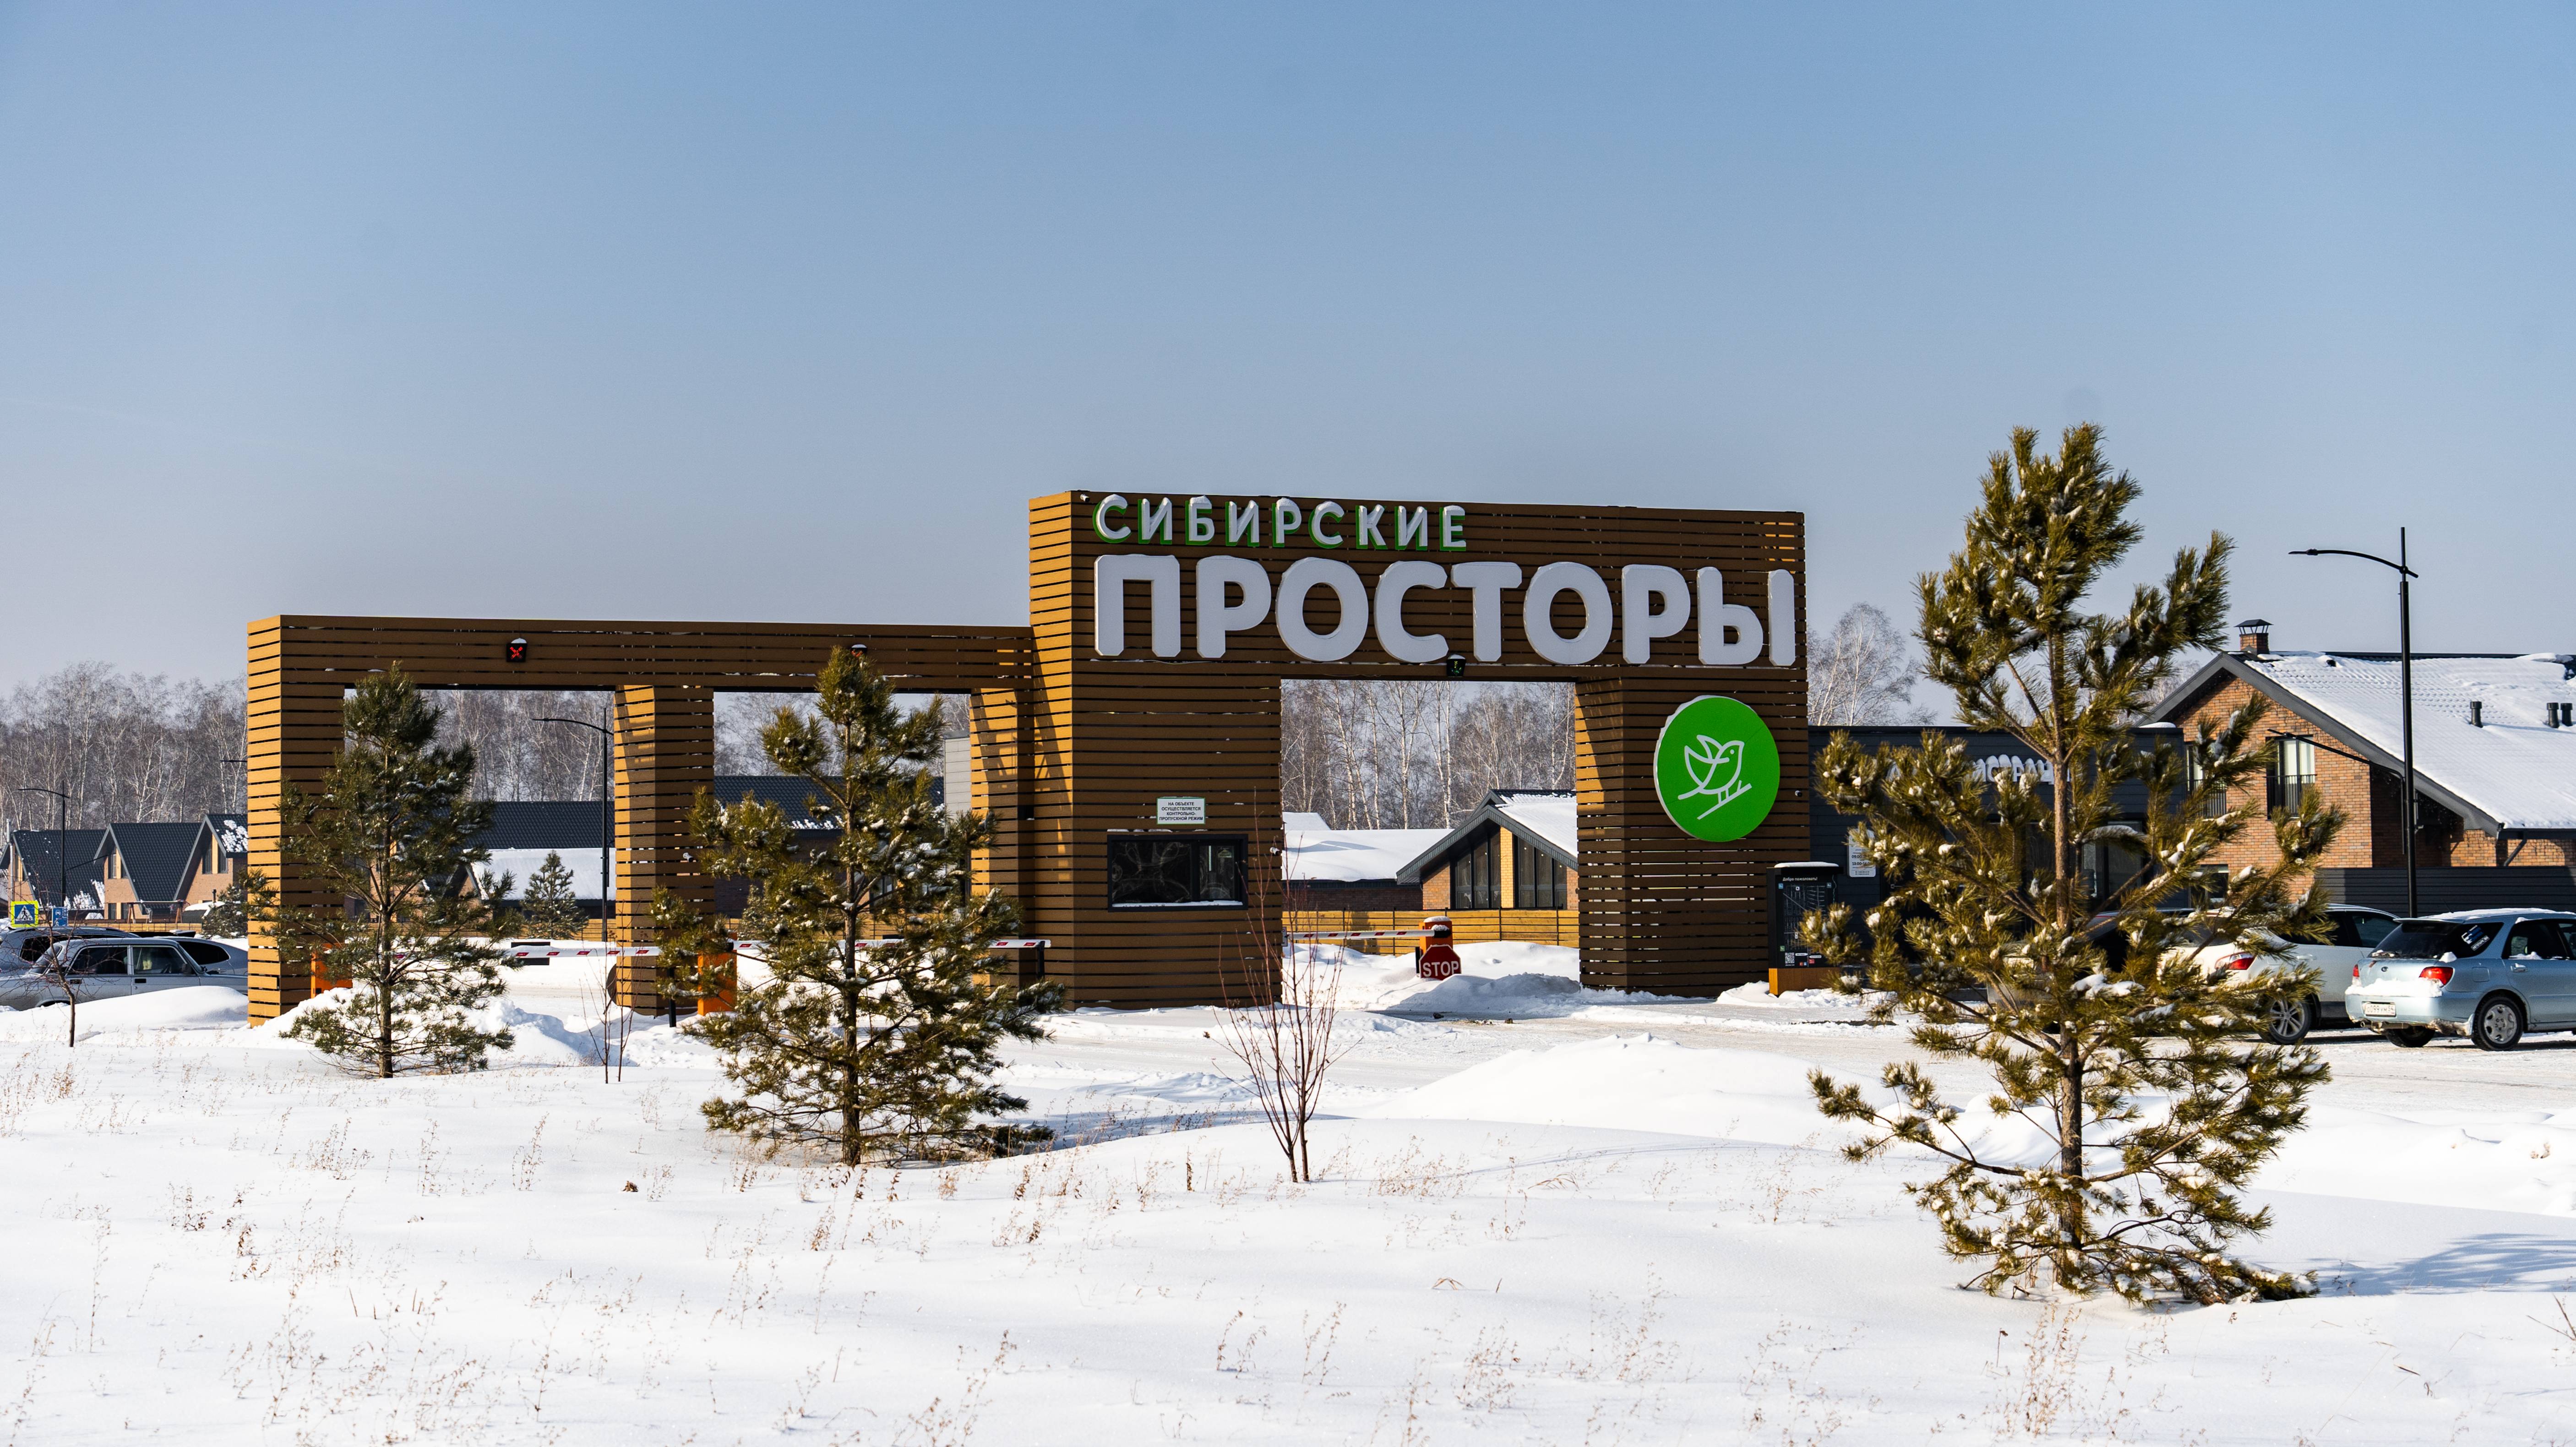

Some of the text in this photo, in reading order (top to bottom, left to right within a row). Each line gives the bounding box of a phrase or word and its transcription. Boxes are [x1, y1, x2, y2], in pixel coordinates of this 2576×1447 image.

[1093, 494, 1466, 551] СИБИРСКИЕ
[1094, 554, 1795, 667] ПРОСТОРЫ
[1422, 961, 1459, 977] STOP
